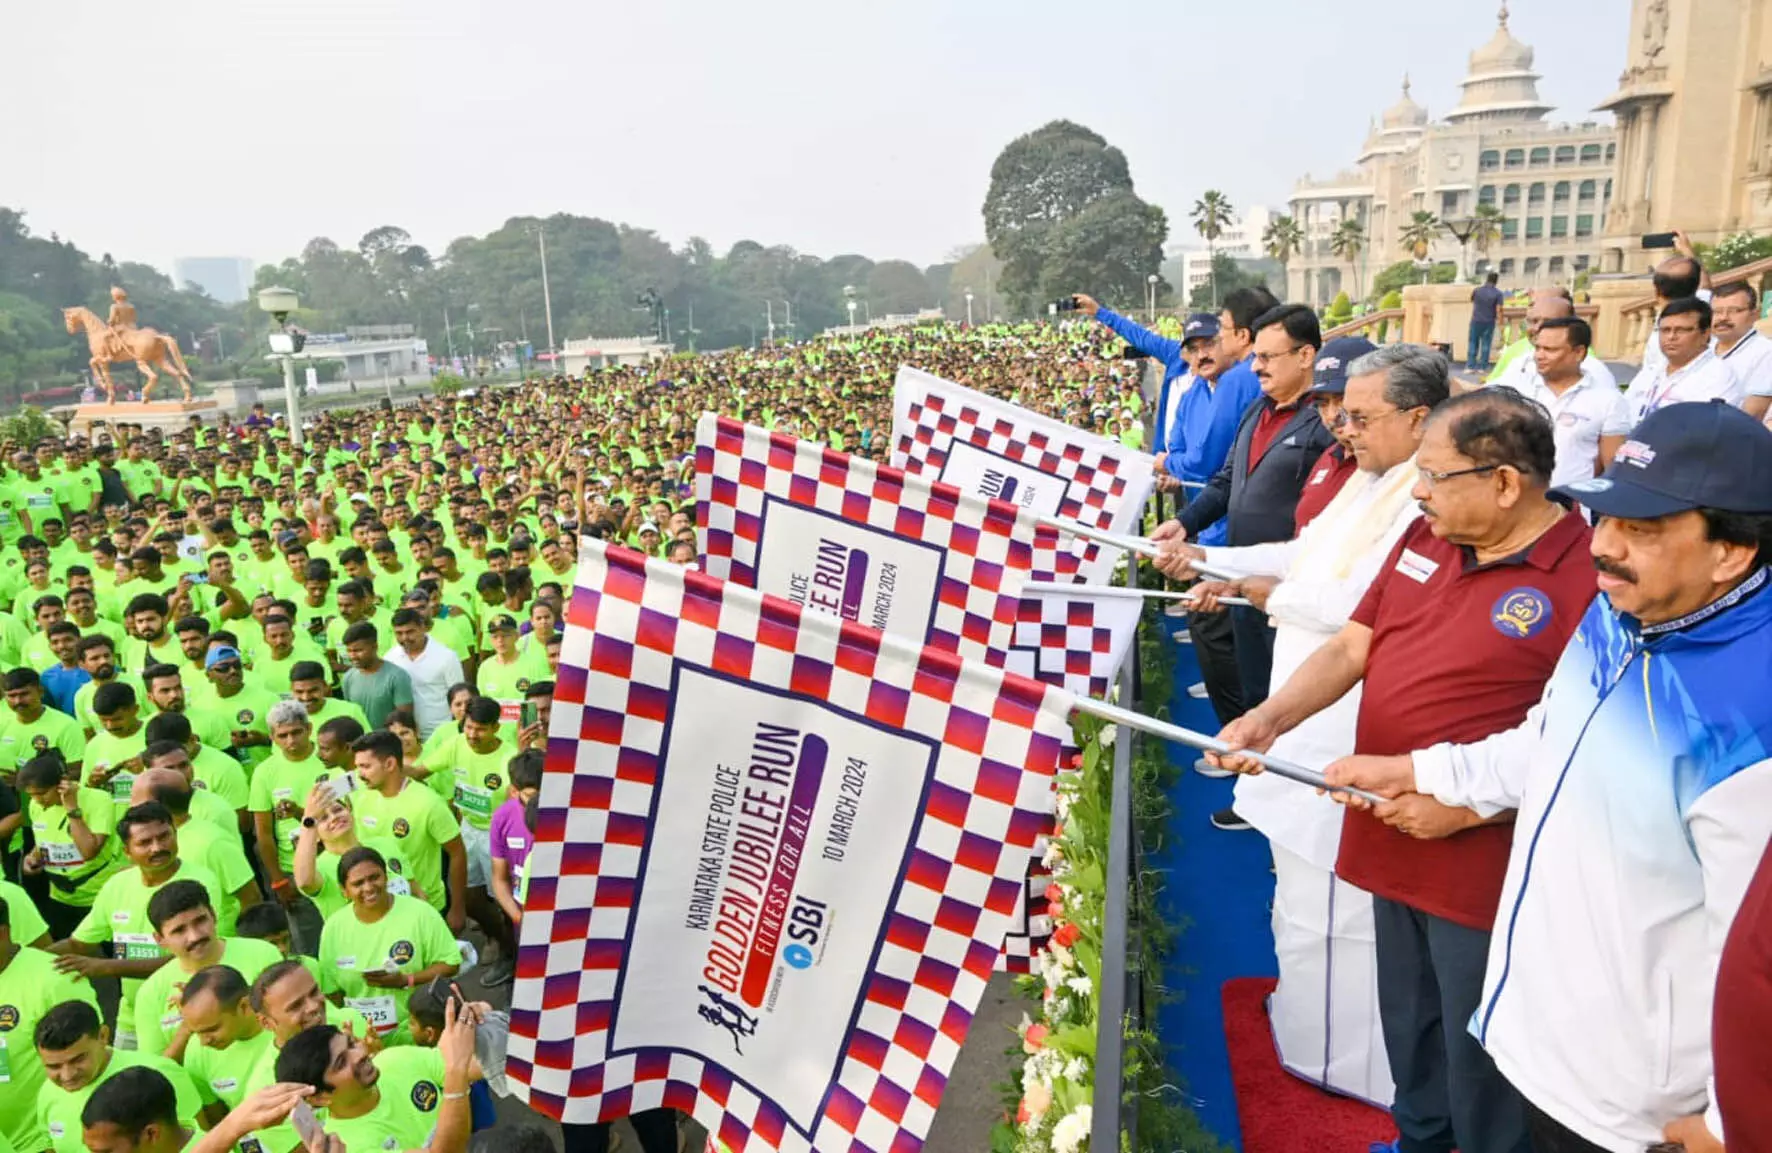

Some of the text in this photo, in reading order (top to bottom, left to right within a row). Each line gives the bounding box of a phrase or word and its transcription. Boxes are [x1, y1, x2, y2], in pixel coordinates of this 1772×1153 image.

[814, 538, 848, 591] RUN
[878, 562, 898, 592] 2024
[788, 804, 811, 840] ALL
[822, 756, 868, 862] 10 MARCH 2024
[686, 763, 741, 931] KARNATAKA STATE POLICE
[703, 722, 800, 993] GOLDEN JUBILEE RUN
[777, 842, 800, 880] FOR
[756, 883, 788, 957] FITNESS
[788, 895, 827, 945] SBI
